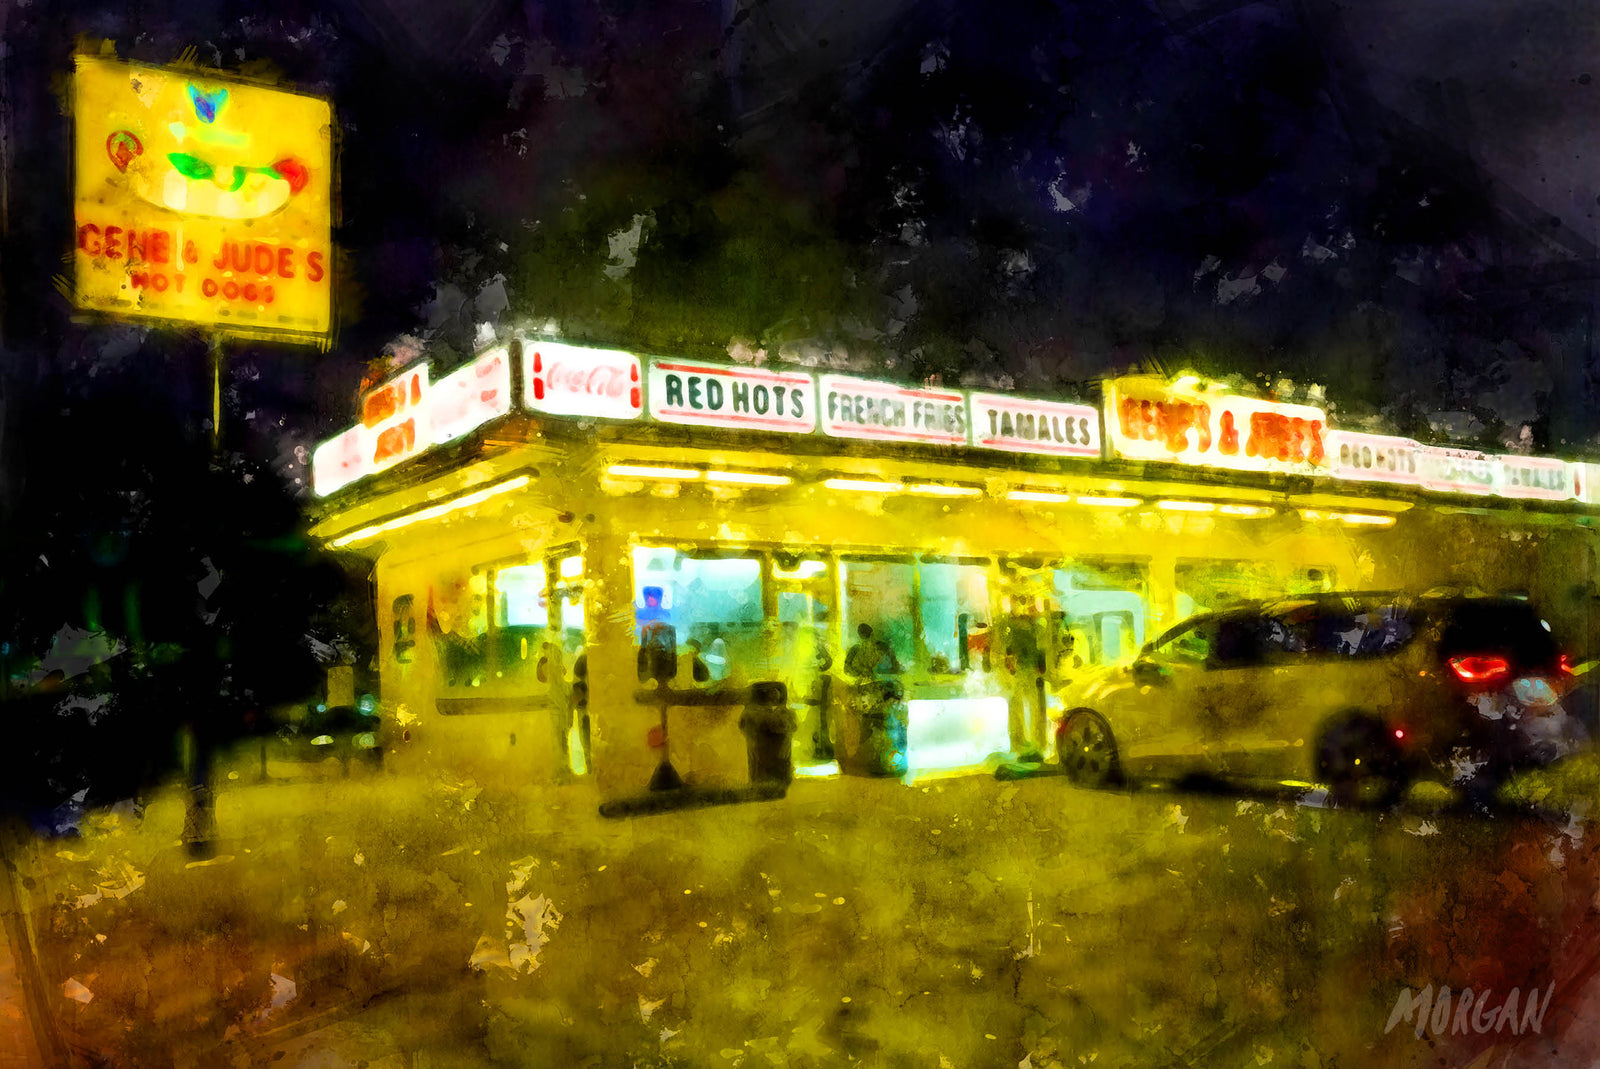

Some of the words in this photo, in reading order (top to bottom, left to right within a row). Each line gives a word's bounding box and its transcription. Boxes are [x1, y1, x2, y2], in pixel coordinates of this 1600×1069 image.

[78, 223, 170, 263] GENE
[213, 241, 324, 283] JUDES
[665, 374, 724, 410] RED
[732, 381, 804, 418] HOTS
[828, 391, 905, 427] FRENCH
[913, 400, 966, 433] FRIES
[987, 409, 1091, 446] TAMALES
